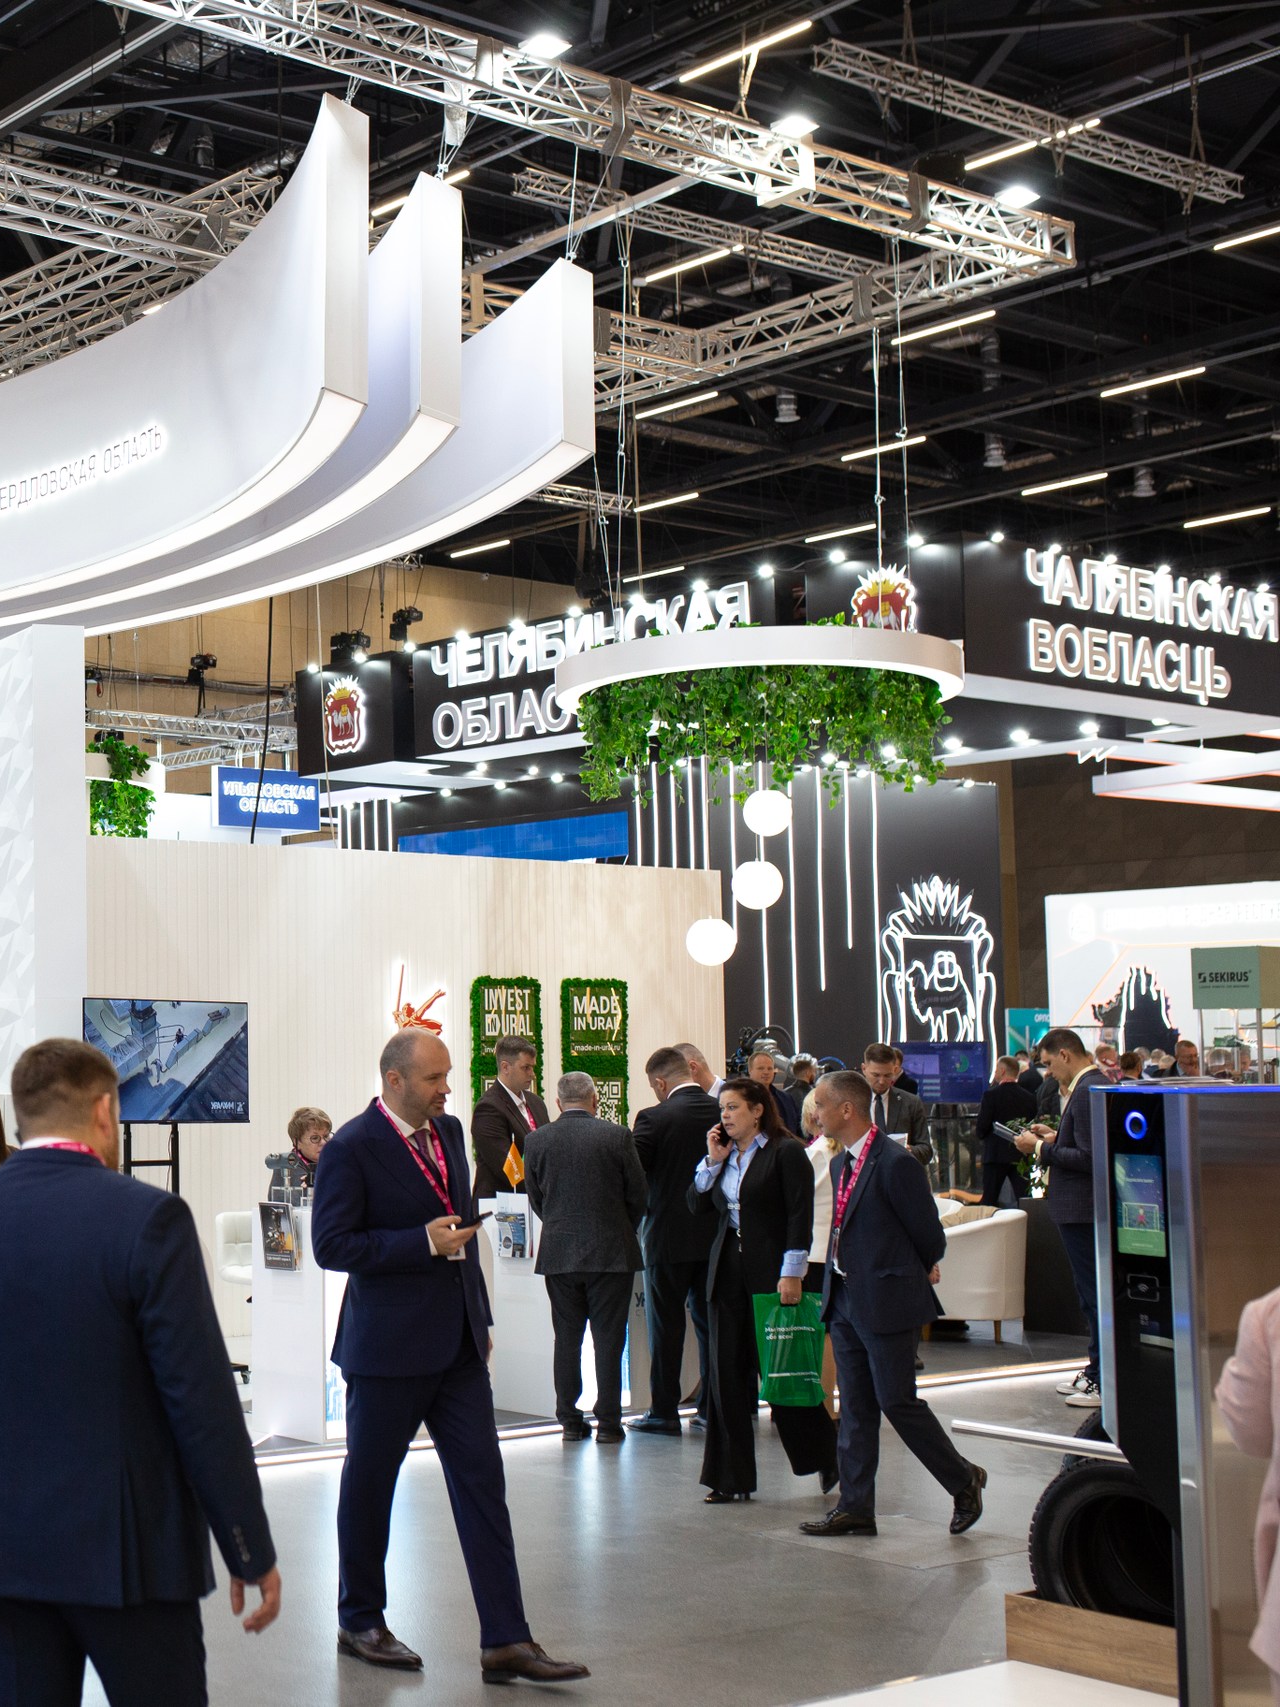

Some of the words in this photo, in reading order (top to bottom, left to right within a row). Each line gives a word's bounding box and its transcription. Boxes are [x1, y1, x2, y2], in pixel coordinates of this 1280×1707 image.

[103, 425, 162, 474] ОБЛАСТЬ
[1028, 617, 1233, 706] ВОБЛАСЦЬ
[432, 683, 572, 749] ОБЛАС
[1208, 971, 1249, 983] SEKIRUS
[484, 988, 531, 1011] INVEST
[573, 995, 620, 1015] MADE
[501, 1014, 534, 1036] URAL
[573, 1016, 587, 1031] IN
[589, 1016, 620, 1031] URAL
